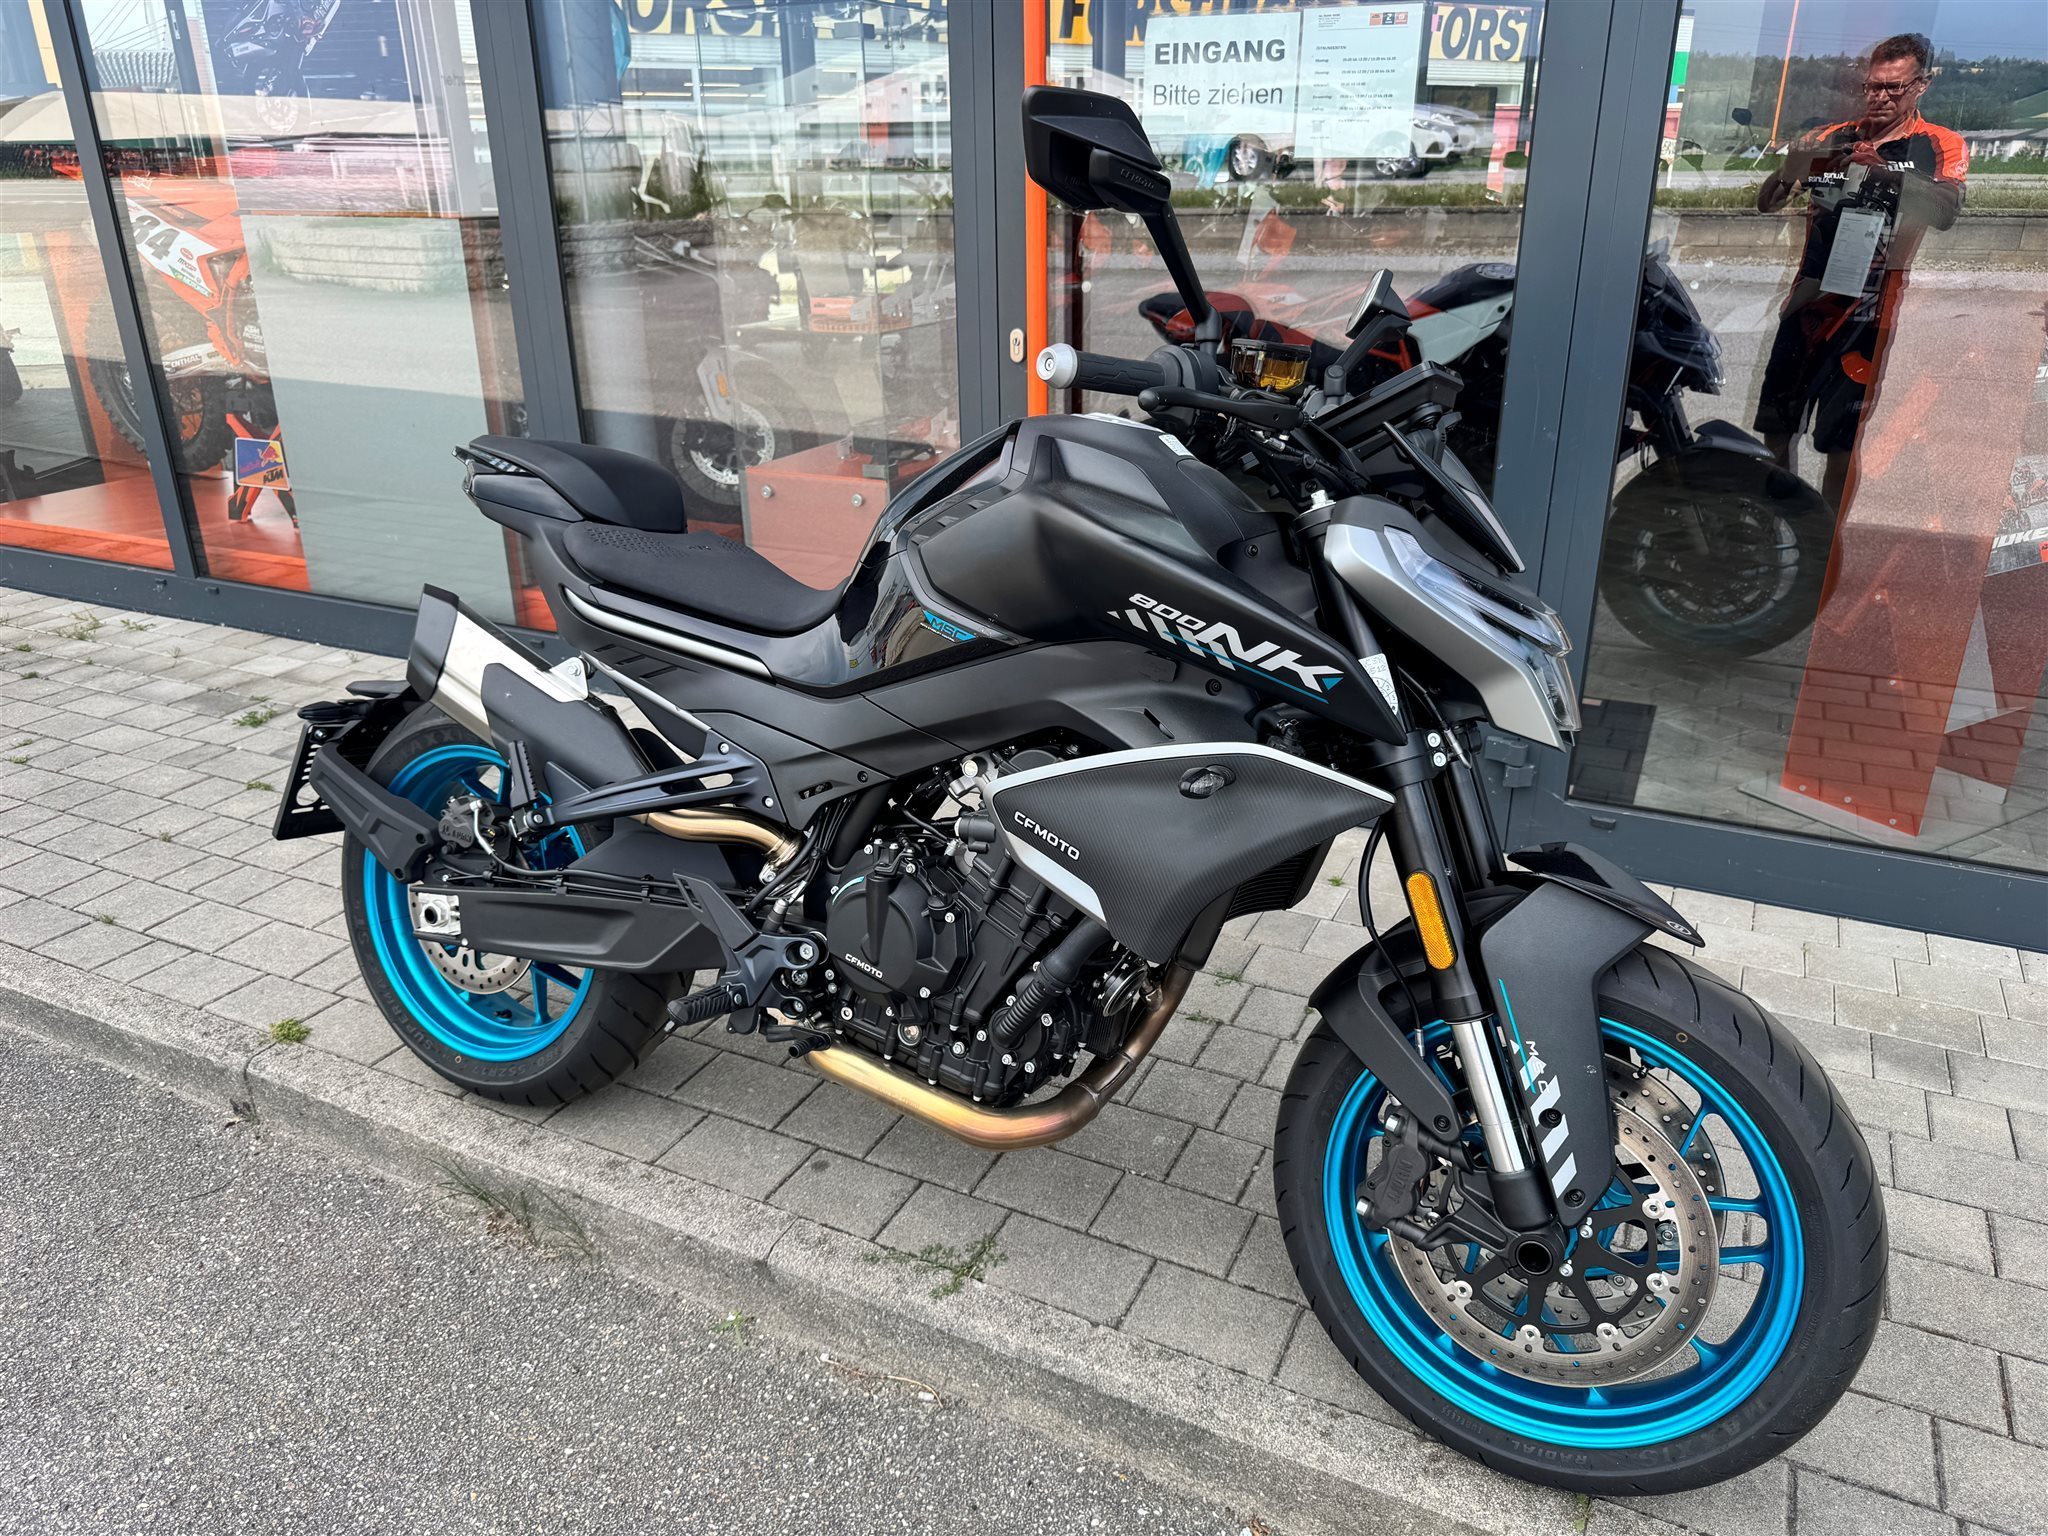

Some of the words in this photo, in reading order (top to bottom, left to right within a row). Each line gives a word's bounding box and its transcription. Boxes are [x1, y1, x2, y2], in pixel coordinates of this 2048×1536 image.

[1154, 39, 1286, 65] EINGANG
[1153, 84, 1201, 106] Bitte
[1207, 82, 1283, 105] ziehen
[1128, 593, 1207, 631] 800
[1194, 621, 1345, 693] NK
[1014, 811, 1080, 861] CFMOTO
[844, 953, 883, 979] CFMOTO
[1511, 1439, 1588, 1466] RADIAL
